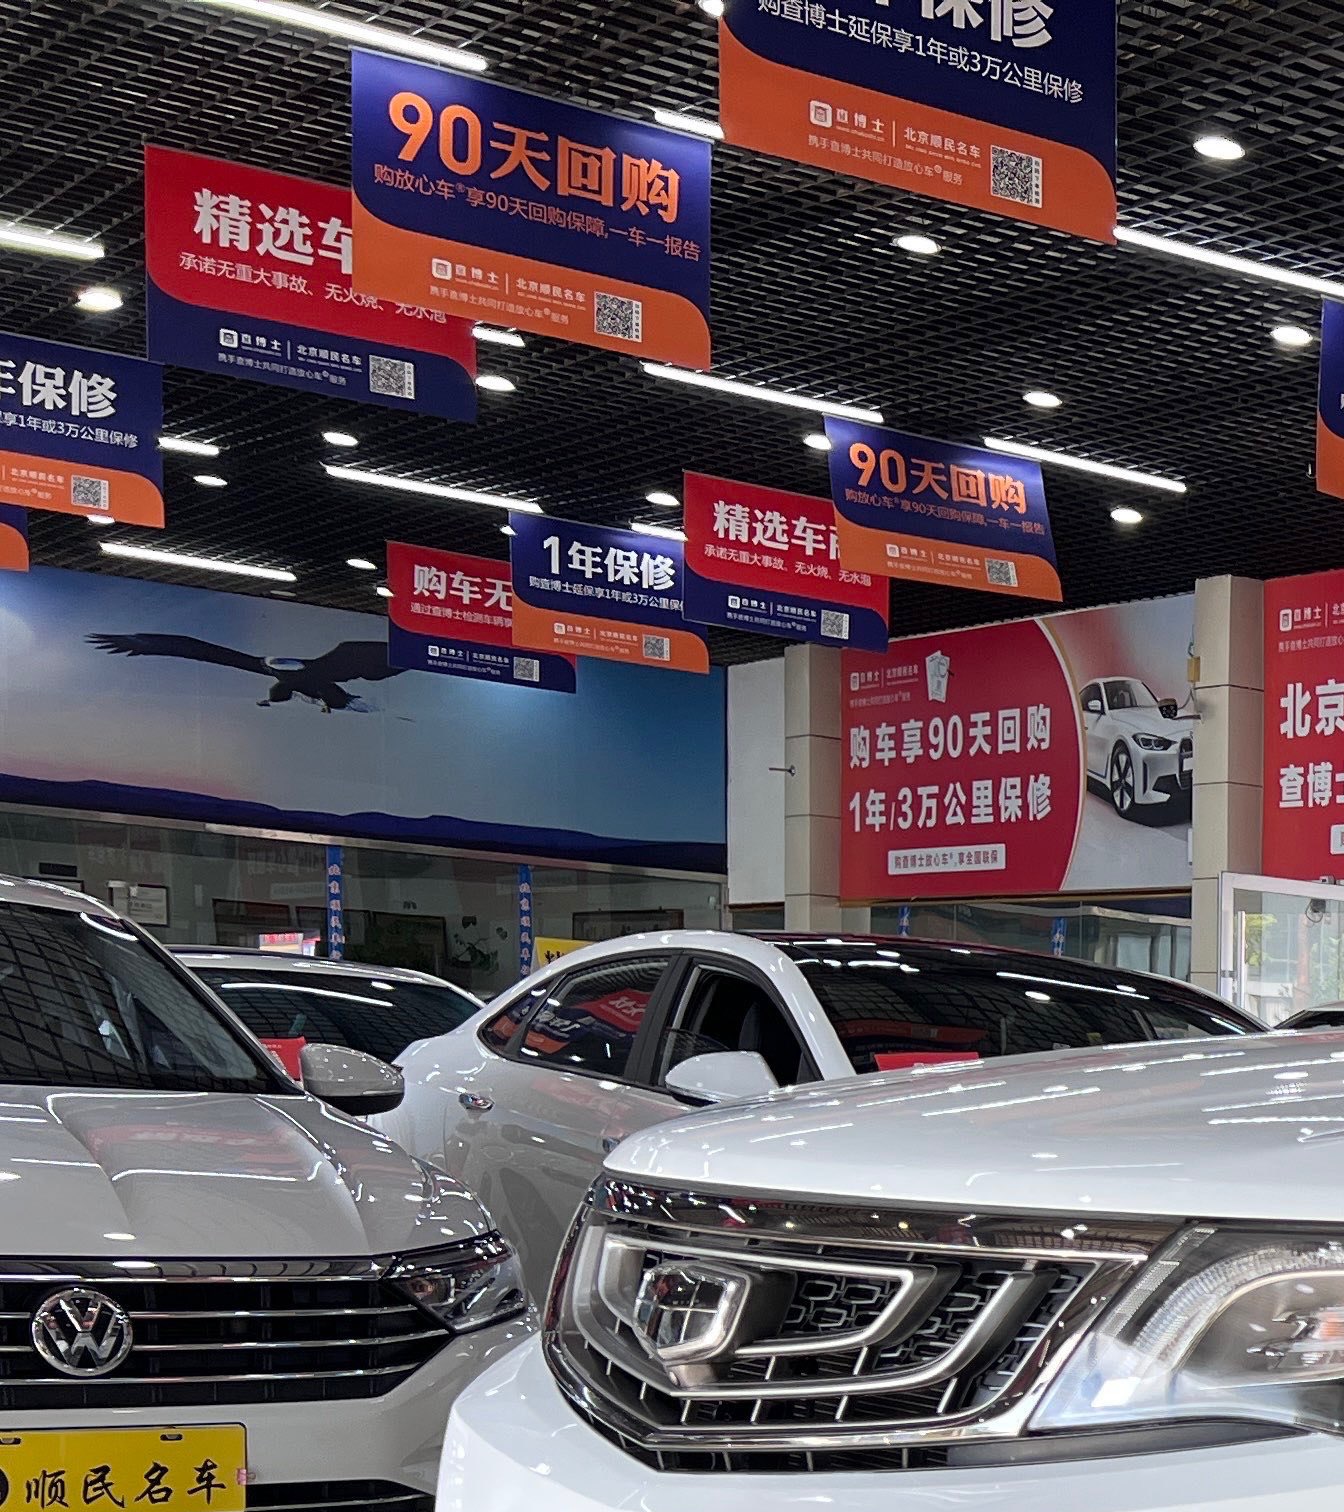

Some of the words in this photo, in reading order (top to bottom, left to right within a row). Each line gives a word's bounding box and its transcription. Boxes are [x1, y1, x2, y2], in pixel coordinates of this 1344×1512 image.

[389, 91, 679, 223] 90天回购
[903, 127, 981, 159] 北京顺民名车
[516, 277, 586, 303] 北京顺民名车
[297, 345, 362, 365] 北京顺民名车
[0, 411, 139, 449] 享1年或3万公里保修
[849, 442, 1027, 514] 90天回购
[713, 500, 841, 560] 精选车
[543, 535, 676, 591] 1年保修
[850, 703, 1050, 769] 购车享90天回购
[849, 773, 1051, 832] 1年/3万公里保修
[26, 1459, 226, 1509] 顺民名车
